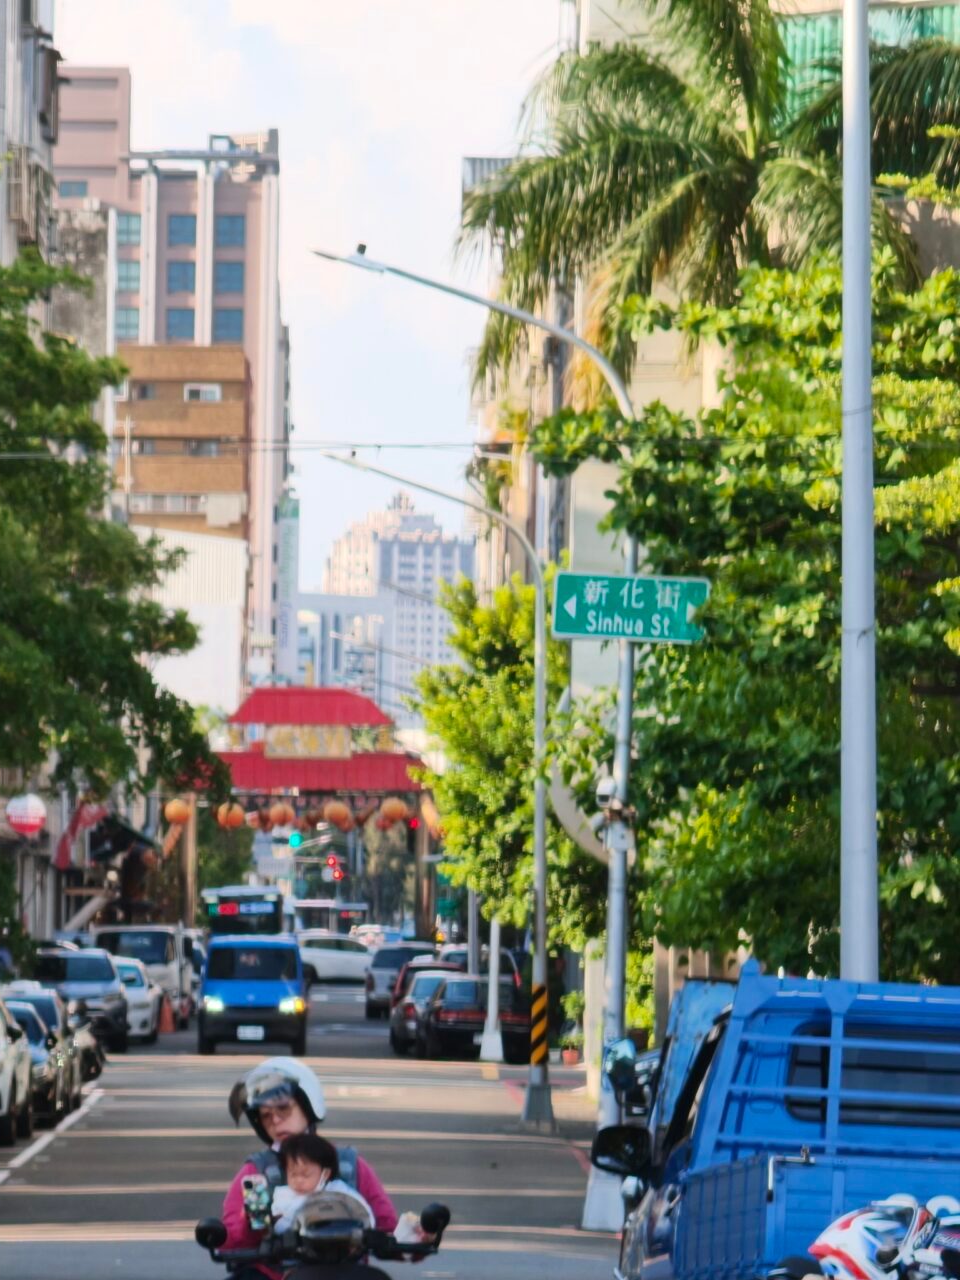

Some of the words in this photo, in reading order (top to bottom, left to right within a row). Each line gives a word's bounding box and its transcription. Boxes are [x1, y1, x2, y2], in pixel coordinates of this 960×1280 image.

[584, 578, 681, 613] 新化街
[586, 610, 644, 636] Sinhua
